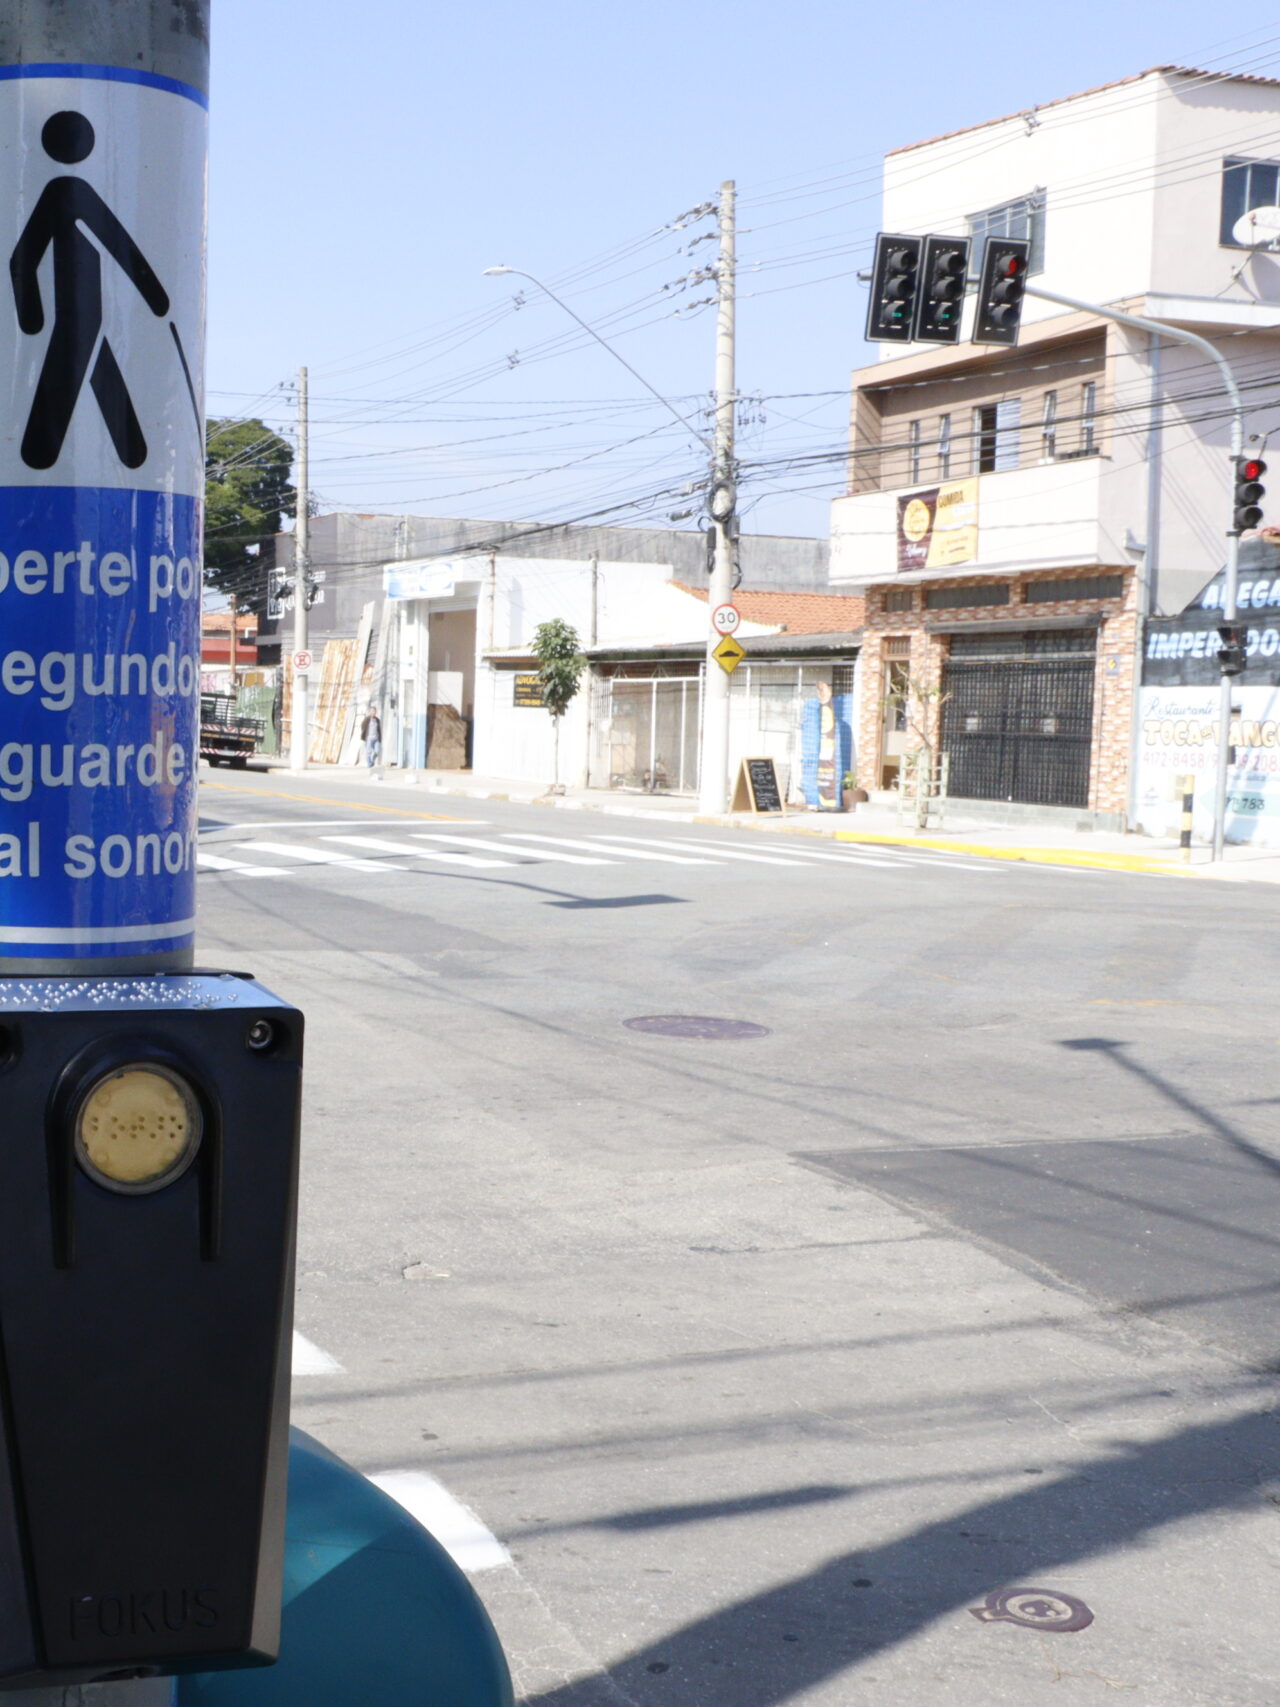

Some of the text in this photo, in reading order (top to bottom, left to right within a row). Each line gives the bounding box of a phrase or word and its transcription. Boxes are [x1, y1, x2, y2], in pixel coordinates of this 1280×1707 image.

[718, 612, 736, 624] 30
[1146, 628, 1280, 660] IMPERDO
[1143, 719, 1204, 747] TOCA
[71, 1584, 218, 1642] FOKUS
